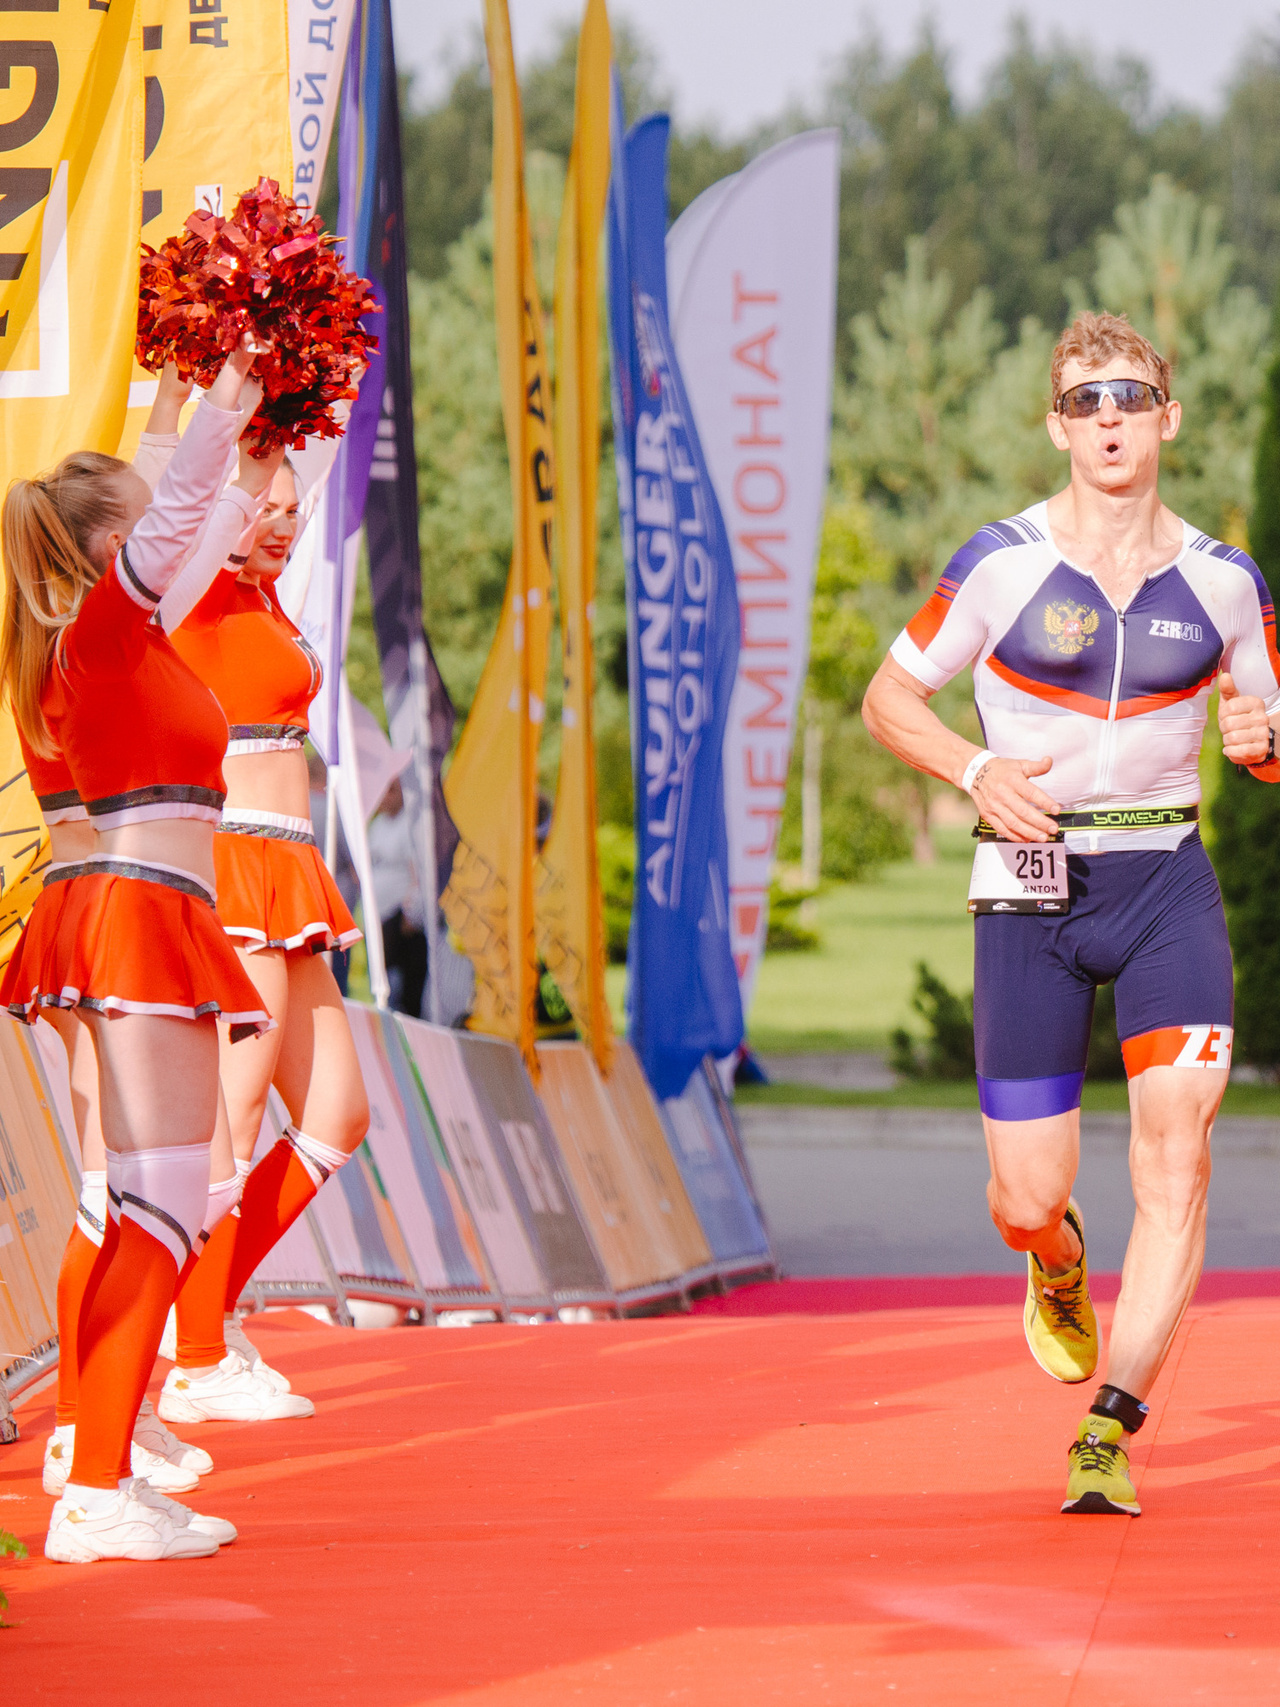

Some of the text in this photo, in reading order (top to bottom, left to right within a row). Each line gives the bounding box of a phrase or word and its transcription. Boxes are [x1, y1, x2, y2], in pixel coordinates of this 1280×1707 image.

[731, 271, 788, 858] ЧЕМПИОНАТ
[1016, 850, 1055, 879] 251
[1022, 885, 1058, 894] ANTON
